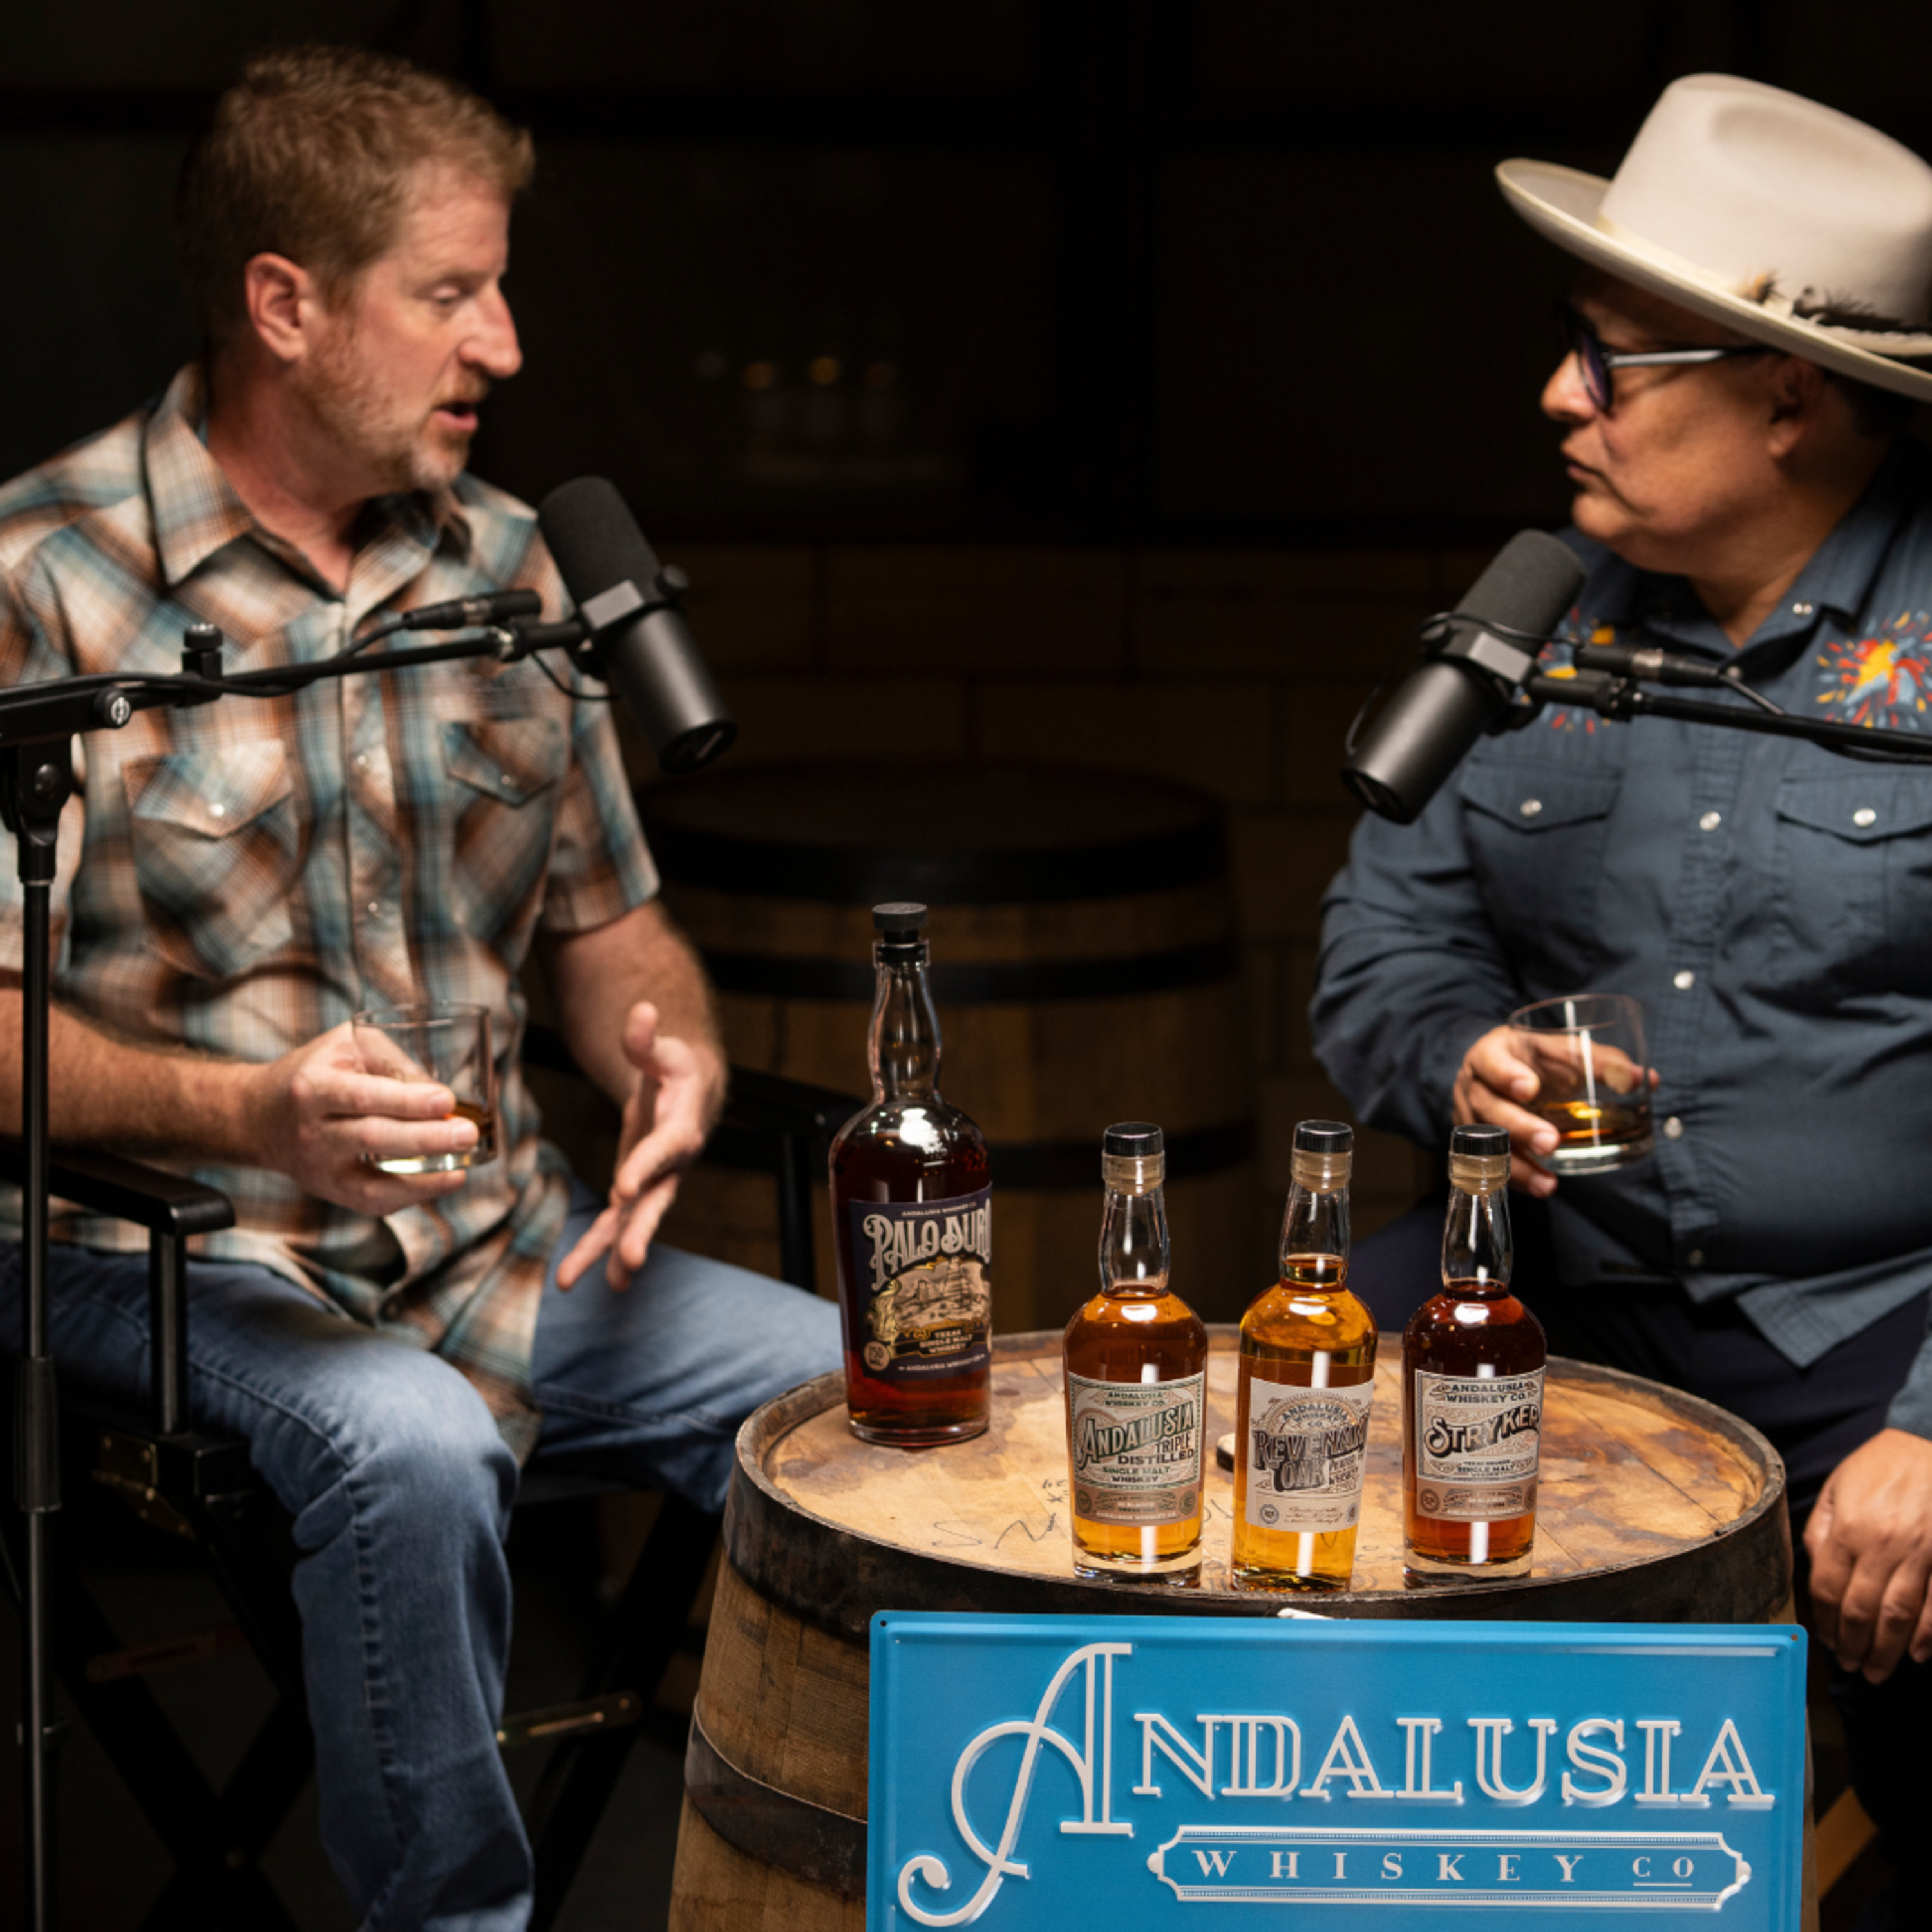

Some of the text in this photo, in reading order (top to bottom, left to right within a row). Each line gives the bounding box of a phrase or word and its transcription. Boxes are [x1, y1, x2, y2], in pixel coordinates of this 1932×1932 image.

[863, 1213, 940, 1291] PALO
[929, 1343, 965, 1353] WHISKEY
[1450, 1383, 1524, 1393] ANDALUSIA
[1447, 1394, 1507, 1403] WHISKEY
[1282, 1403, 1348, 1421] ANDALUSIA
[1293, 1413, 1340, 1423] WHISKEY
[1077, 1400, 1195, 1471] ANDALUSIA
[1425, 1404, 1539, 1458] STRYKER
[1155, 1431, 1191, 1454] TRIPLE
[1117, 1448, 1194, 1465] DISTILLED
[1102, 1466, 1171, 1475] SINGLE MALT
[1276, 1460, 1327, 1492] OAK
[898, 1642, 1776, 1927] ANDALUSIA
[1191, 1850, 1695, 1882] WHISKEY CO
